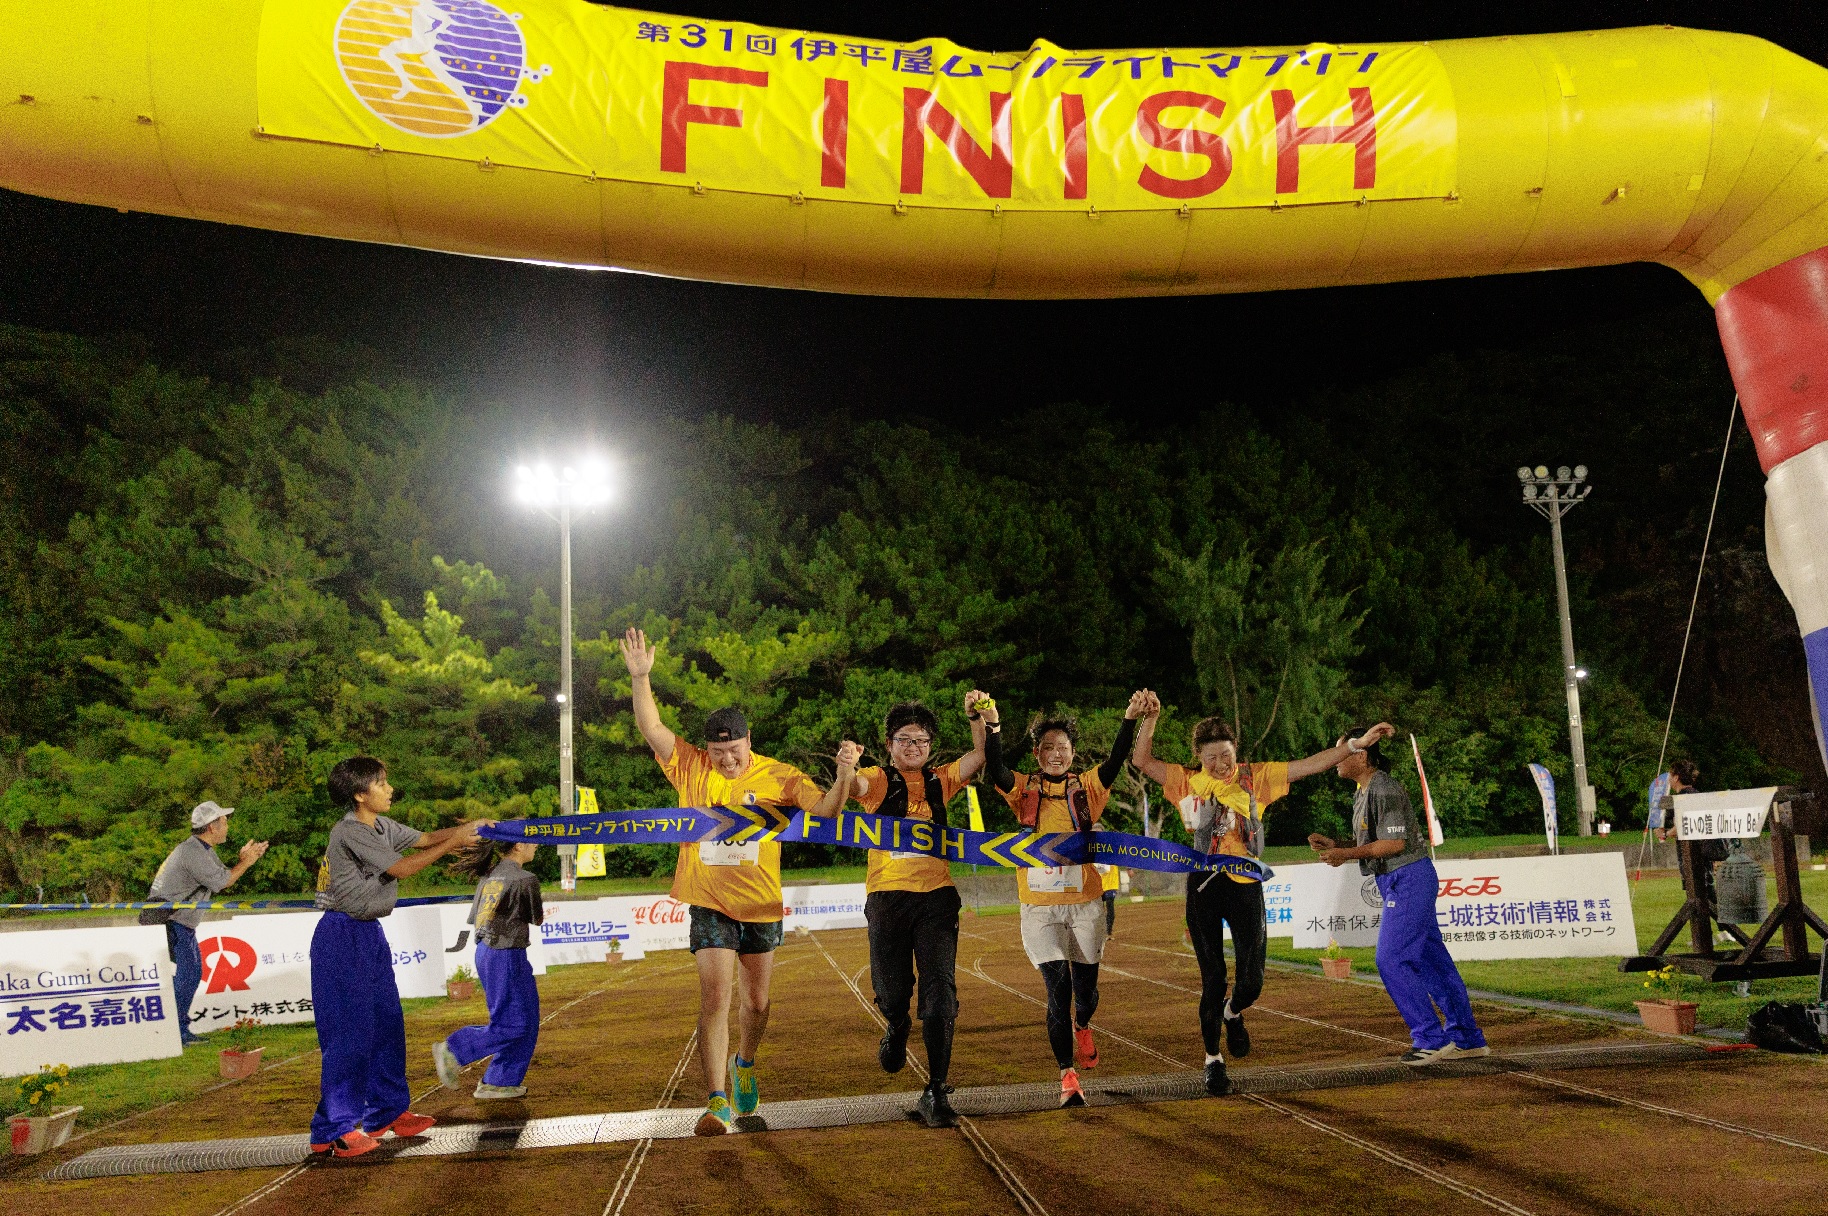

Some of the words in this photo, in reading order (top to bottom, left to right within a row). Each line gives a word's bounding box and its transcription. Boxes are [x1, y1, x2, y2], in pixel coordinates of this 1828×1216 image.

[660, 60, 1377, 200] FINISH
[524, 817, 696, 838] 伊平屋ムーンライトマラソン
[802, 811, 965, 860] FINISH
[1386, 826, 1406, 834] STAFF
[1088, 842, 1114, 853] IHEYA
[1117, 844, 1192, 867] MOONLIGHT
[1193, 861, 1255, 874] MARATHO
[37, 968, 92, 989] Gumi
[98, 963, 160, 984] Co.Ltd
[6, 995, 166, 1035] 太名嘉組
